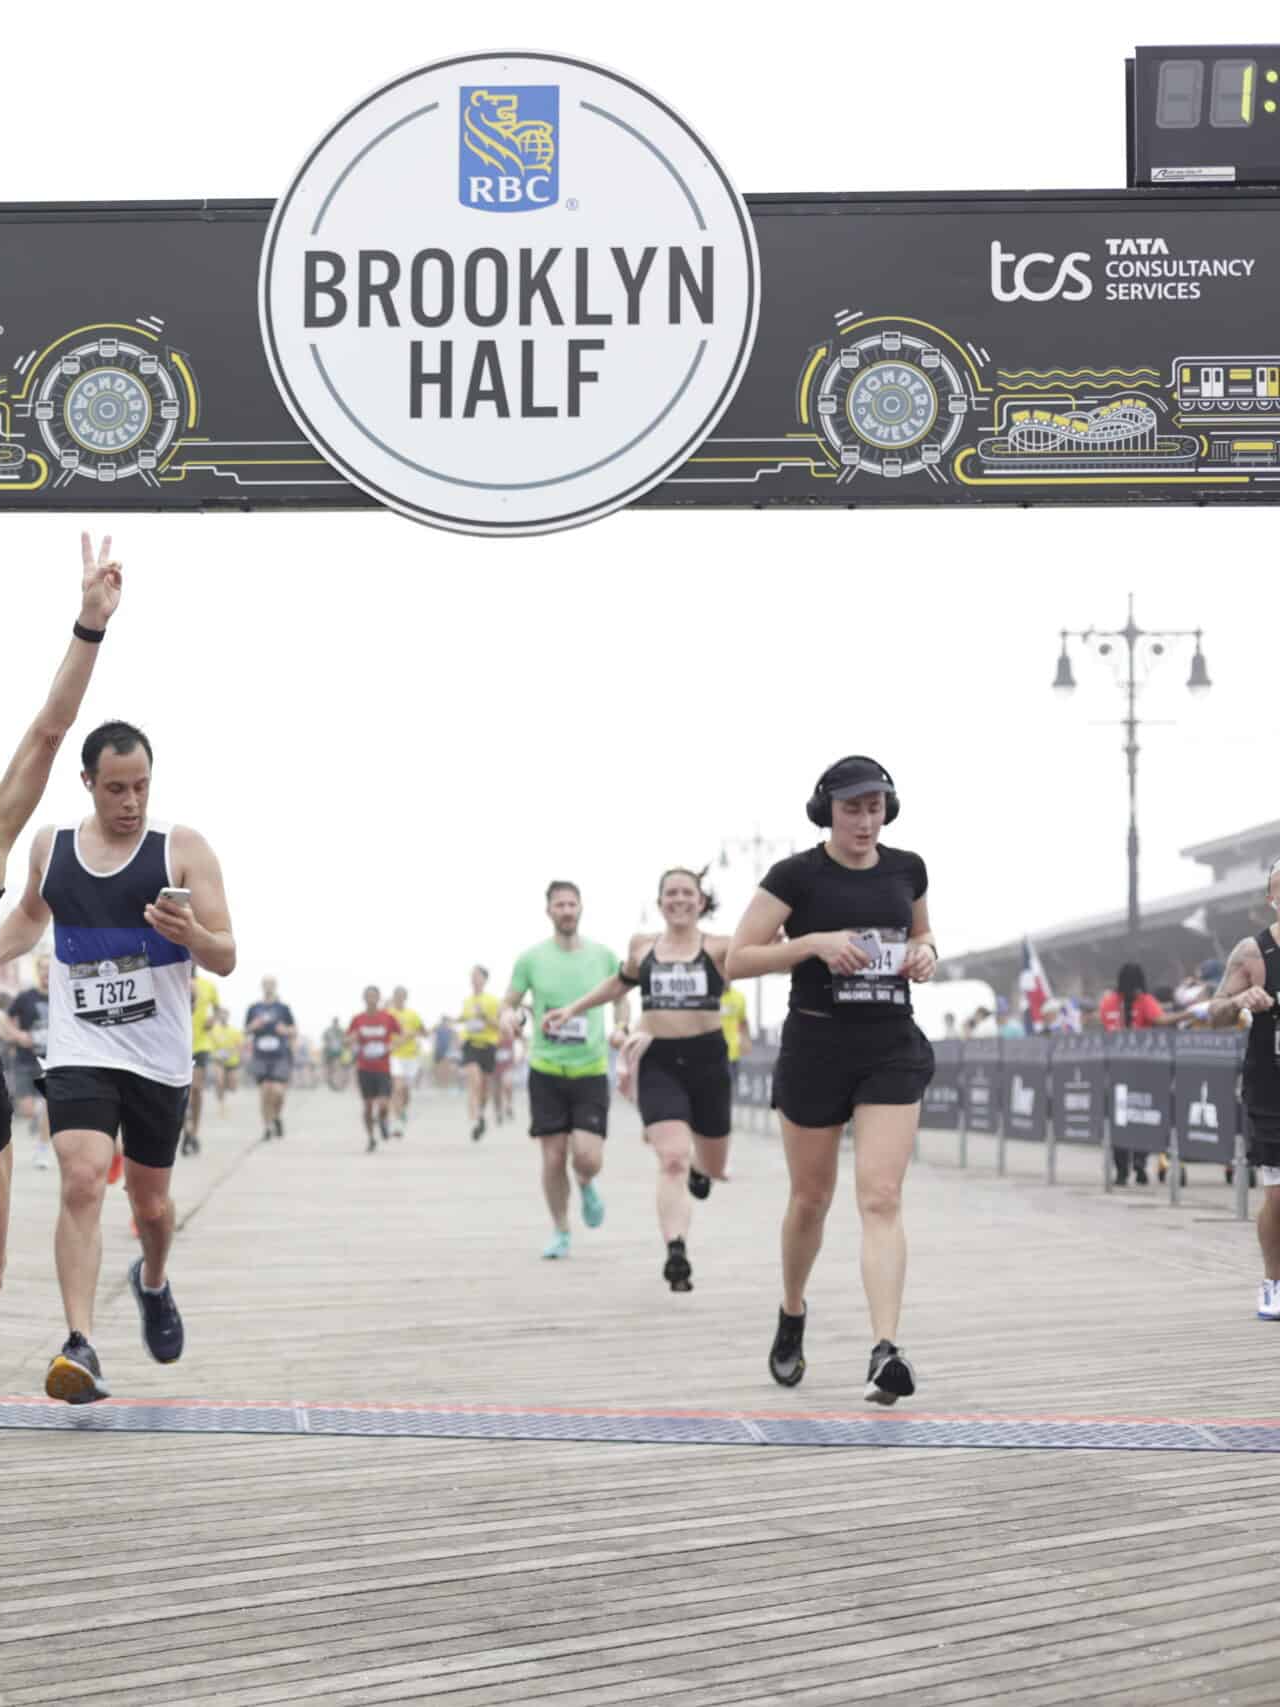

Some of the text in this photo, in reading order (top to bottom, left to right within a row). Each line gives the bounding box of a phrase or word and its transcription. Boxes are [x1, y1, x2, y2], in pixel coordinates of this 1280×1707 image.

[467, 175, 552, 203] RBC
[1105, 239, 1169, 255] TATA
[1105, 259, 1255, 278] CONSULTANCY
[303, 246, 715, 329] BROOKLYN
[1105, 282, 1201, 300] SERVICES
[409, 339, 605, 419] HALF
[856, 370, 928, 406] WONDER
[74, 979, 137, 1009] E 7372
